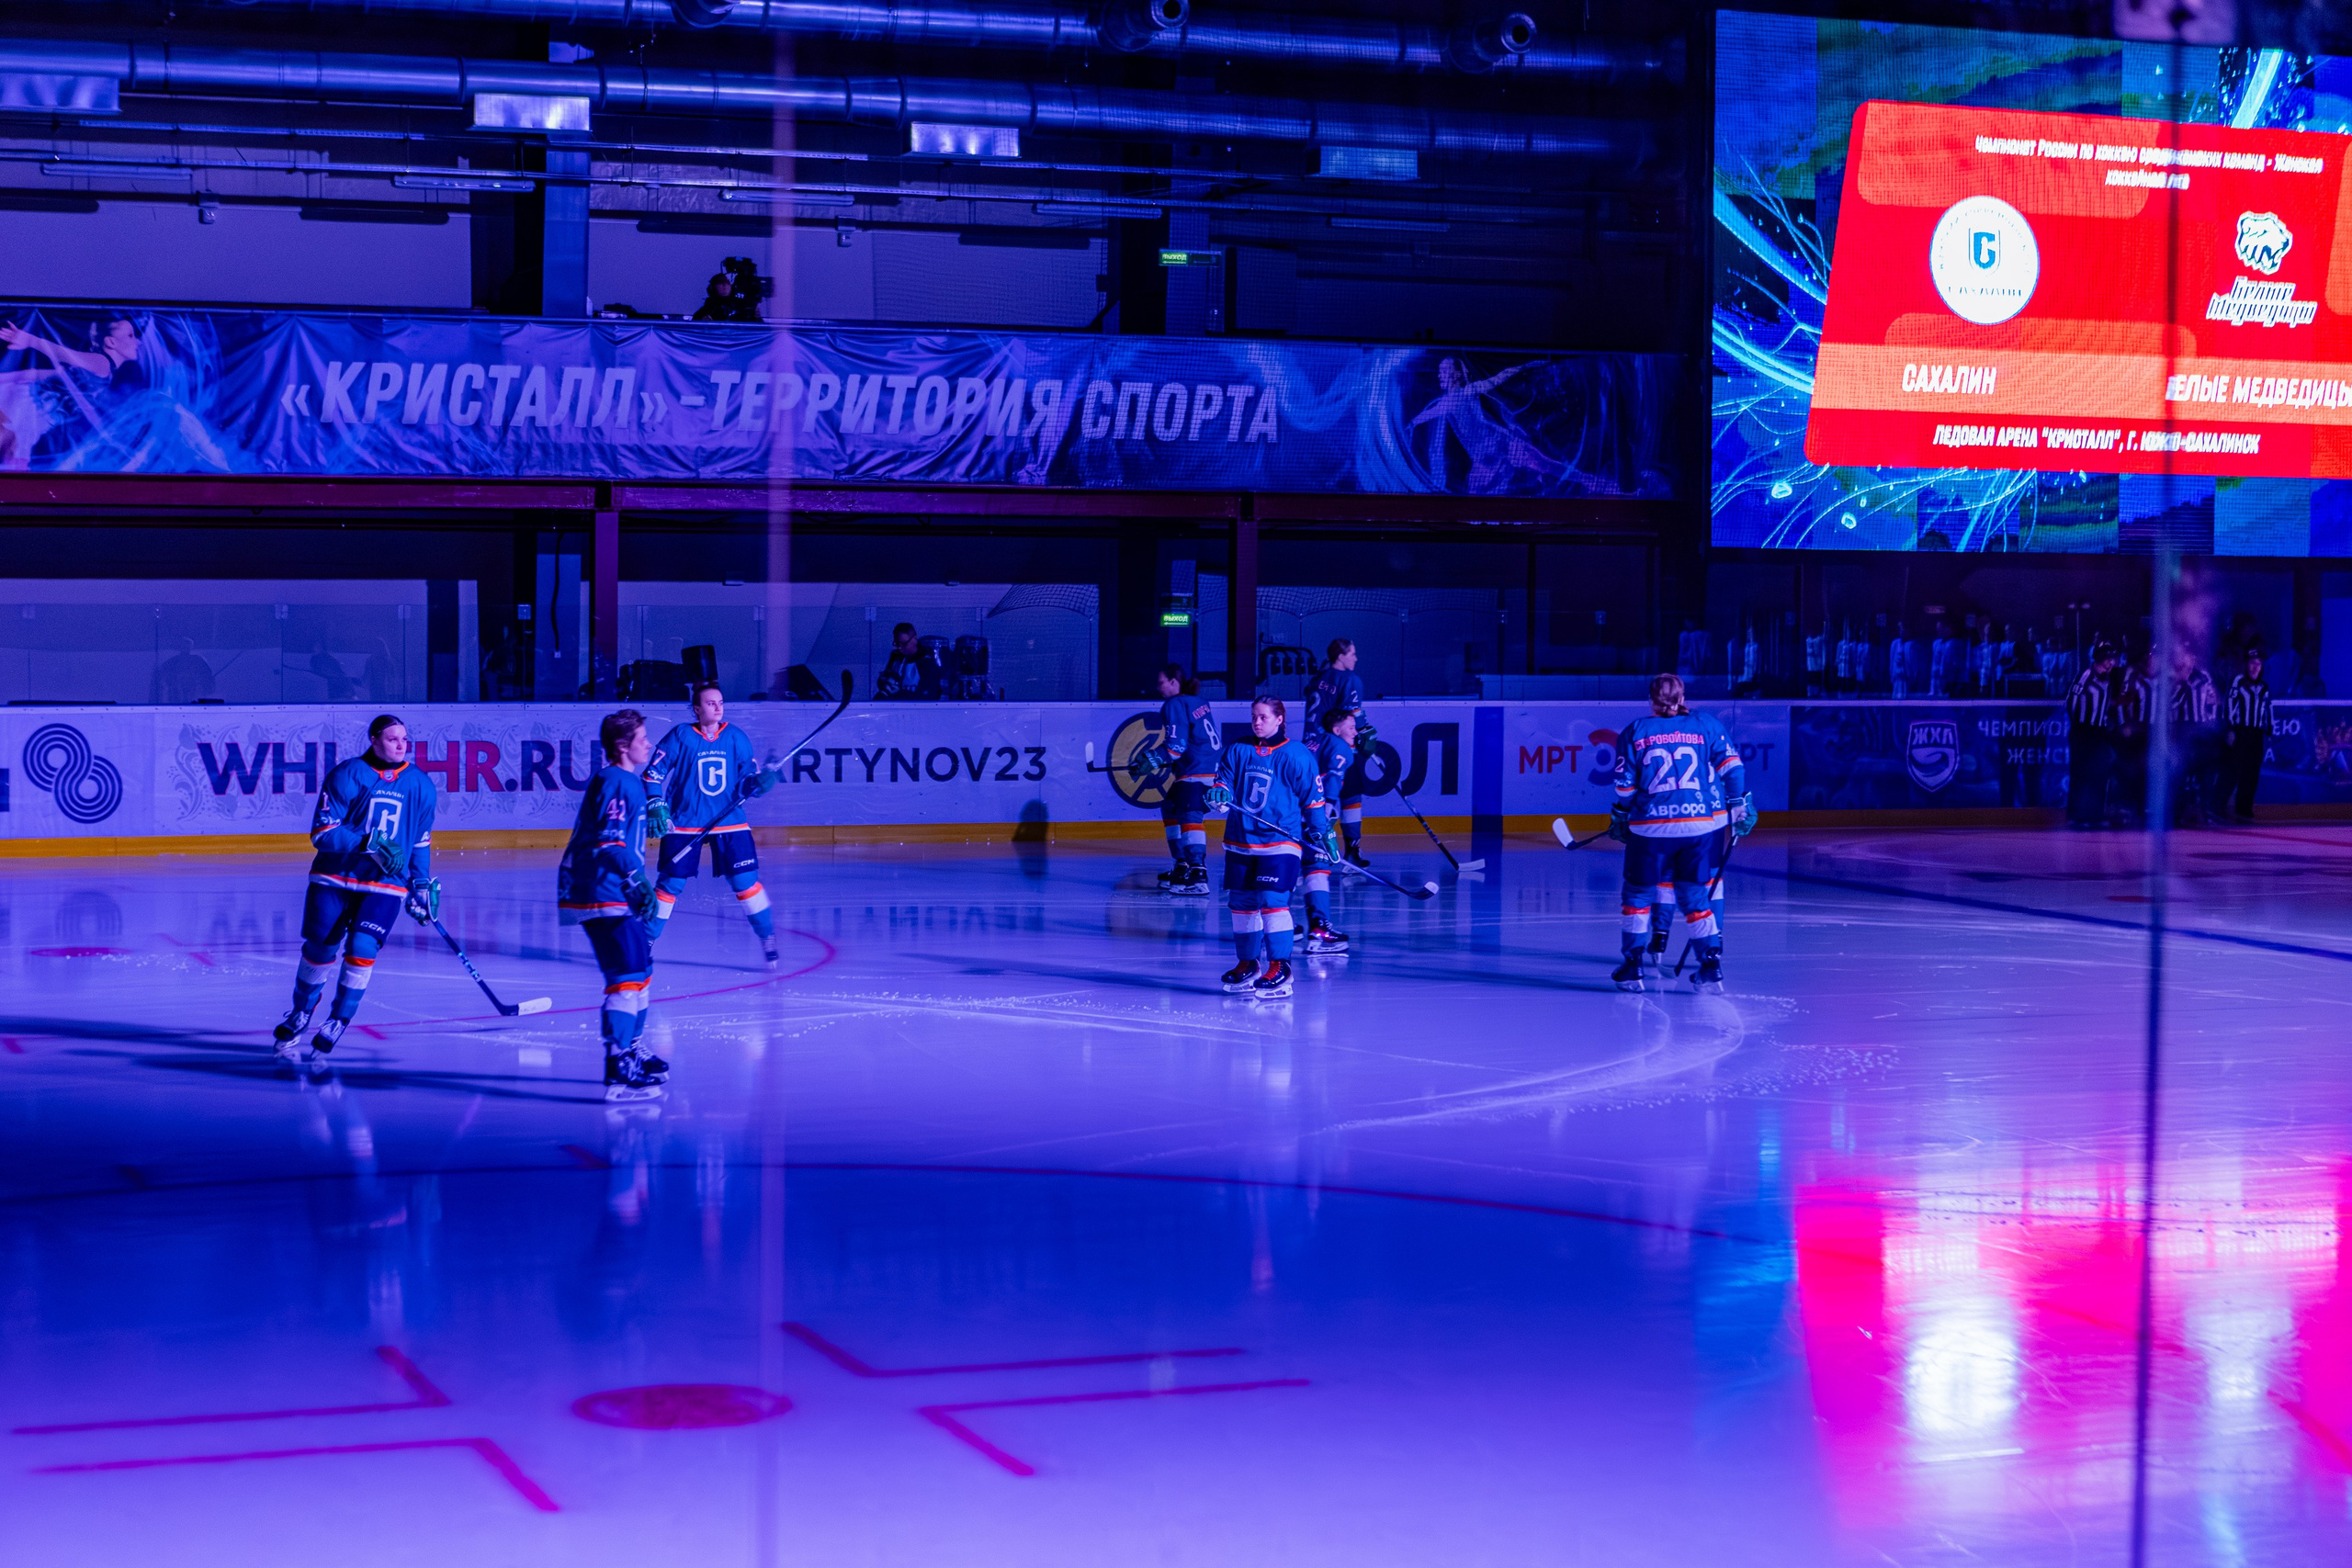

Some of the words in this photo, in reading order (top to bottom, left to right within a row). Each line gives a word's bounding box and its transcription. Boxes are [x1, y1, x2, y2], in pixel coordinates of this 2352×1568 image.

[1902, 364, 1997, 395] САХАЛИН
[2165, 374, 2230, 403] ЕЛЫЕ
[2233, 376, 2352, 410] МЕДВЕДИЦЫ
[1080, 379, 1279, 443] СПОРТА
[1933, 424, 1996, 448] ЛЕДОВАЯ
[1996, 427, 2038, 448] АРЕНА
[1163, 615, 1189, 623] ВЫХОД
[1634, 731, 1705, 751] СТАРОВОЙТОВА
[1912, 727, 1954, 746] ЖХЛ
[1519, 745, 1583, 774] МРТ
[1643, 746, 1701, 795] 22
[1645, 803, 1706, 819] Аврора
[733, 858, 756, 869] CCM
[1256, 875, 1280, 884] CCM
[359, 920, 387, 935] CCM
